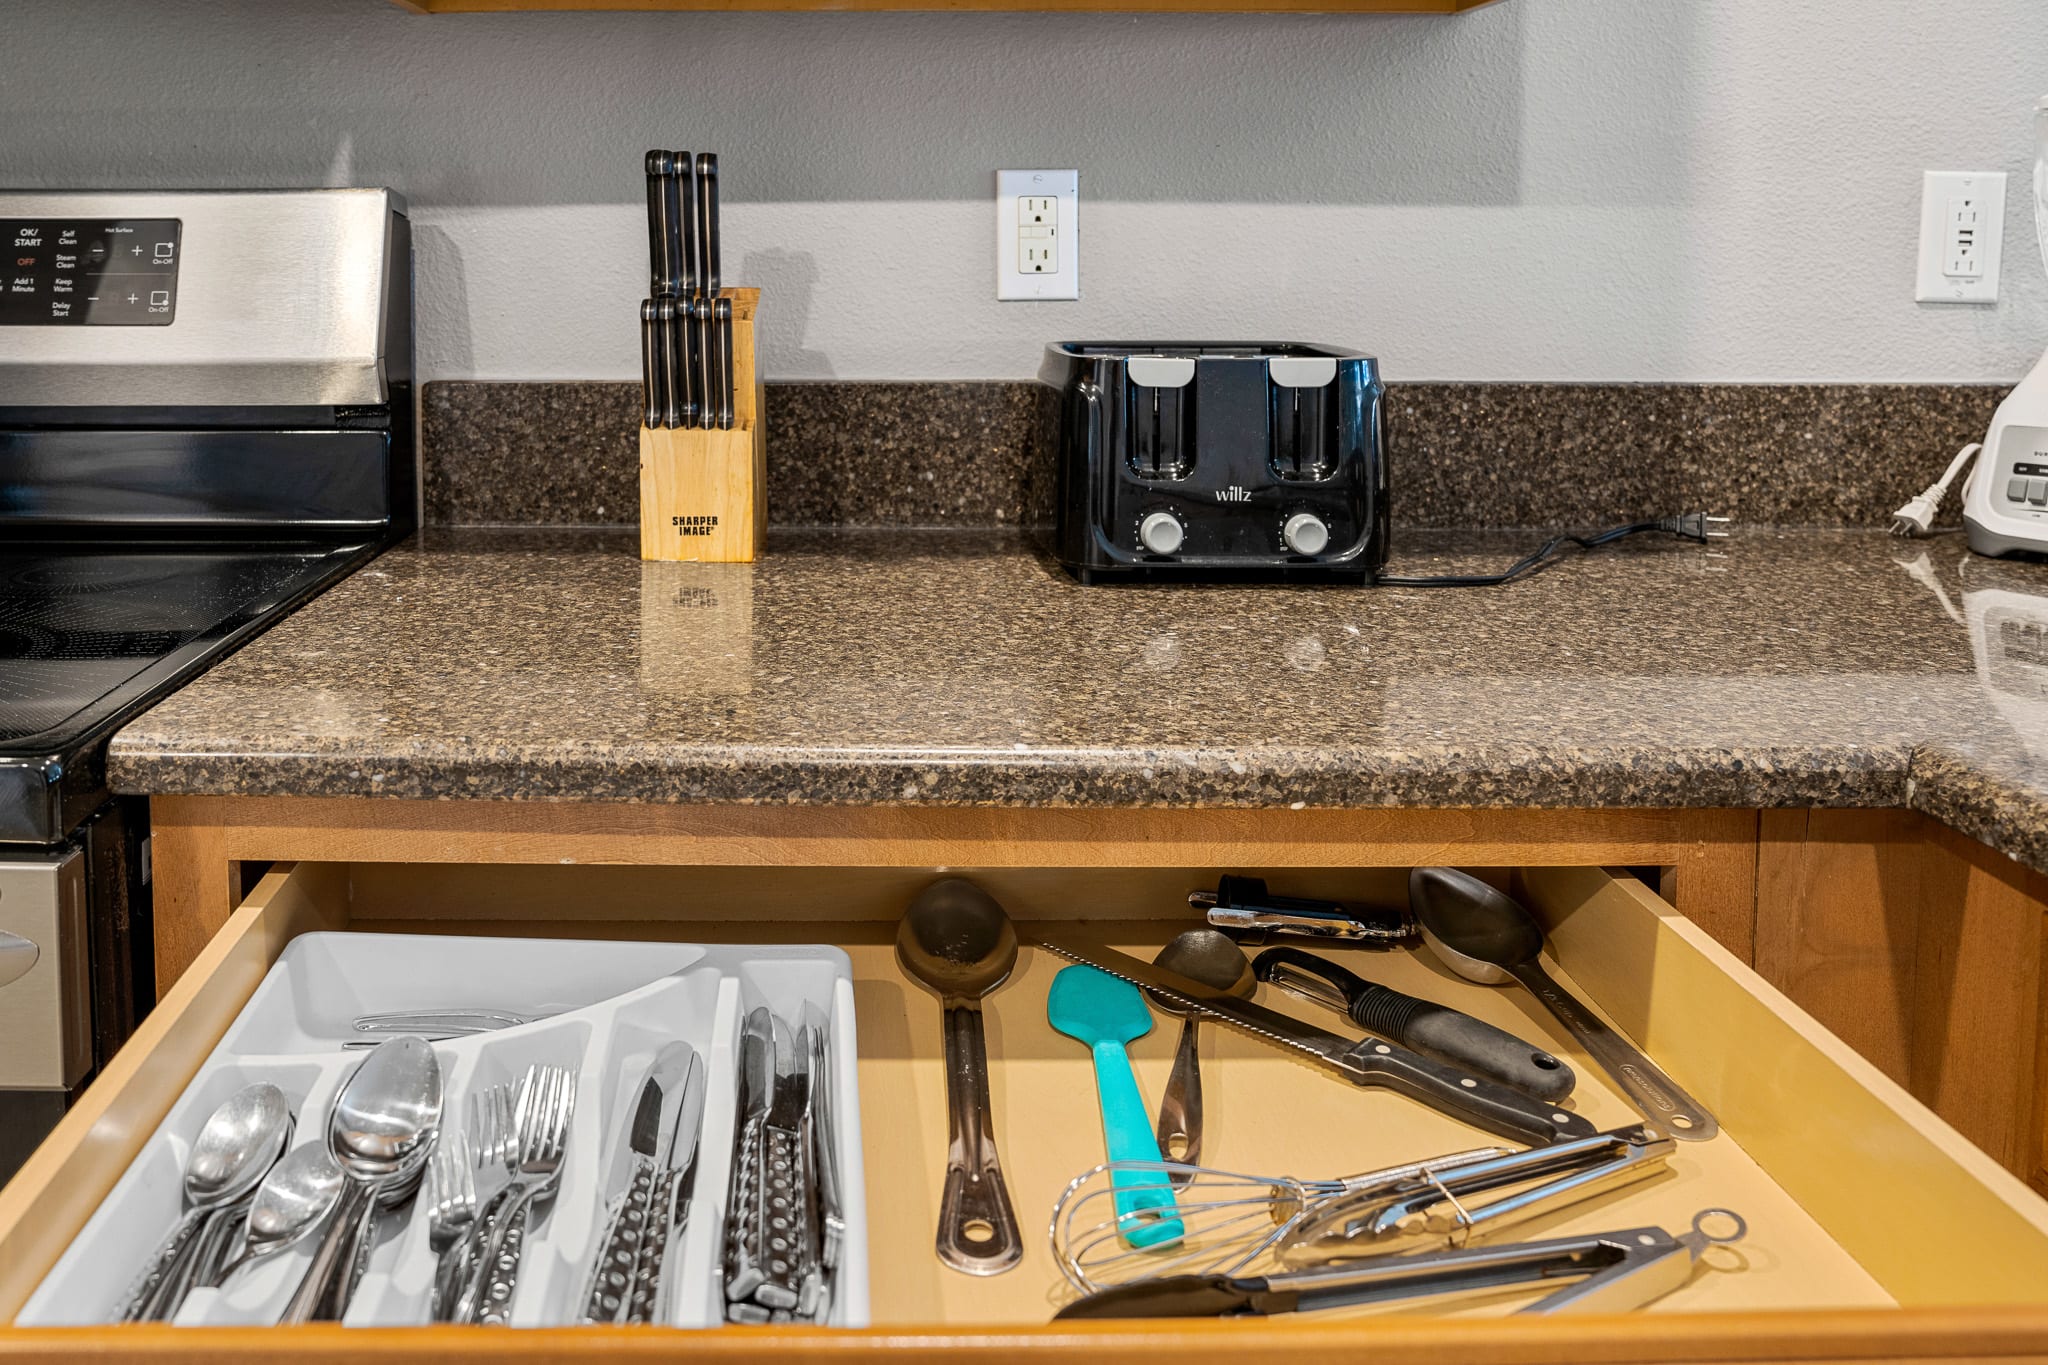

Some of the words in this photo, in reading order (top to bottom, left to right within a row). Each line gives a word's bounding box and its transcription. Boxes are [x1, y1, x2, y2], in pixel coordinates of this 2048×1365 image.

[20, 228, 39, 237] OK/
[14, 238, 42, 246] START
[17, 258, 36, 266] OFF
[55, 278, 72, 286] Keep
[52, 302, 71, 310] Delay
[1215, 486, 1252, 502] willz
[672, 516, 718, 526] SHARPER
